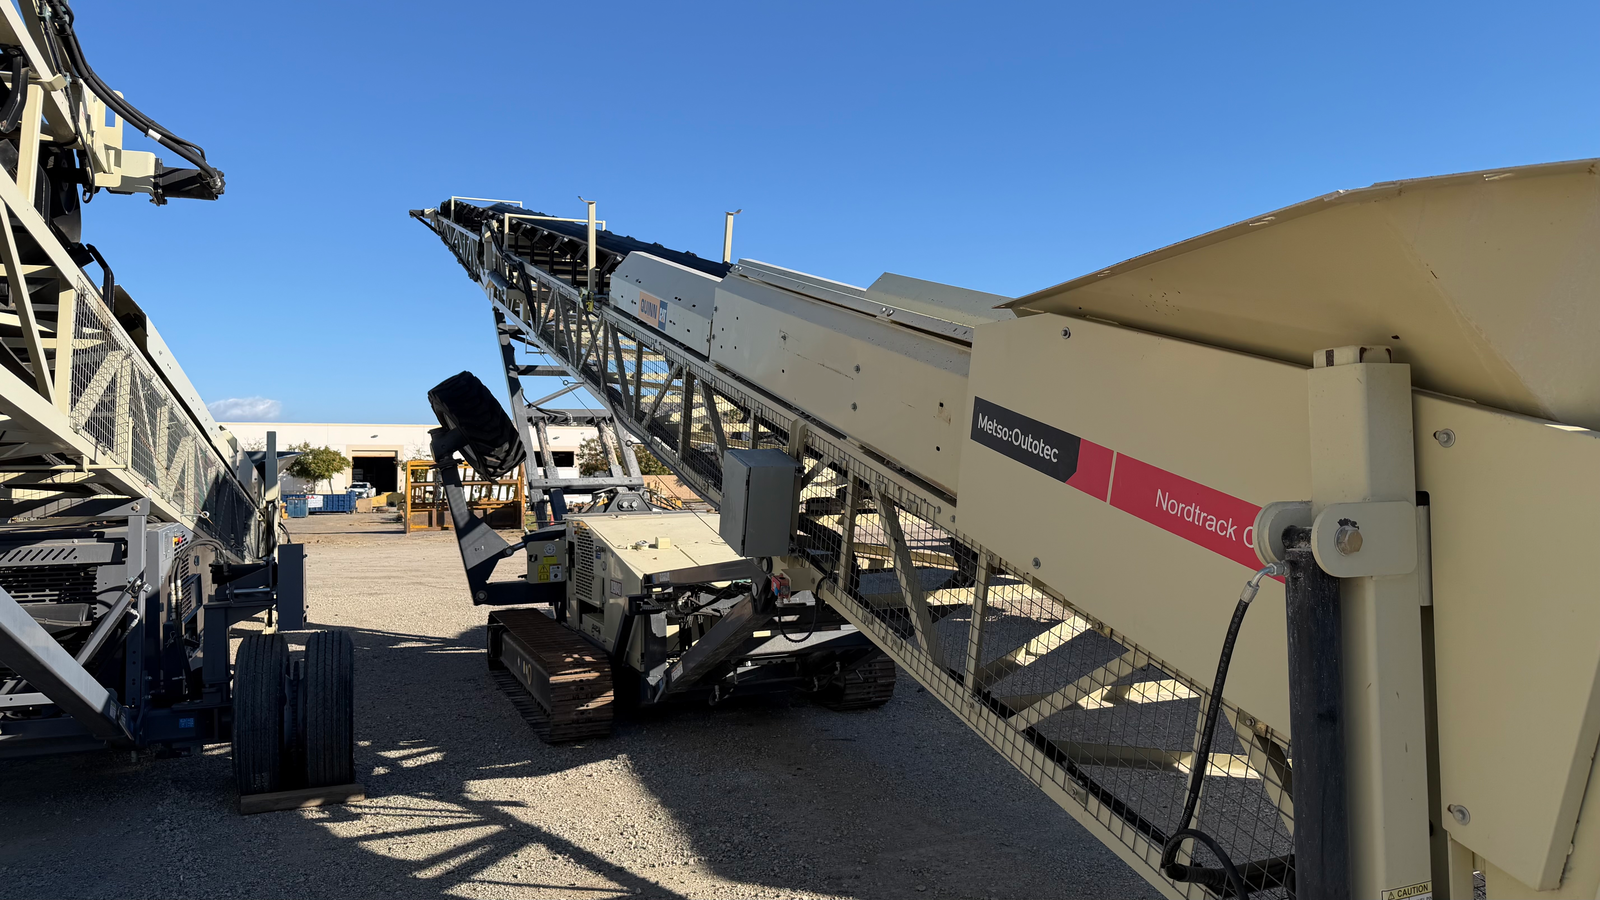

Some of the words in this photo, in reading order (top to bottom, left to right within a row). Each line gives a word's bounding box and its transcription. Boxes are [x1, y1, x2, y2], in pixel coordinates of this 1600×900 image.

[977, 412, 1059, 463] Metso:Outotec
[1155, 488, 1237, 541] Nordtrack
[1397, 884, 1429, 898] CAUTION
